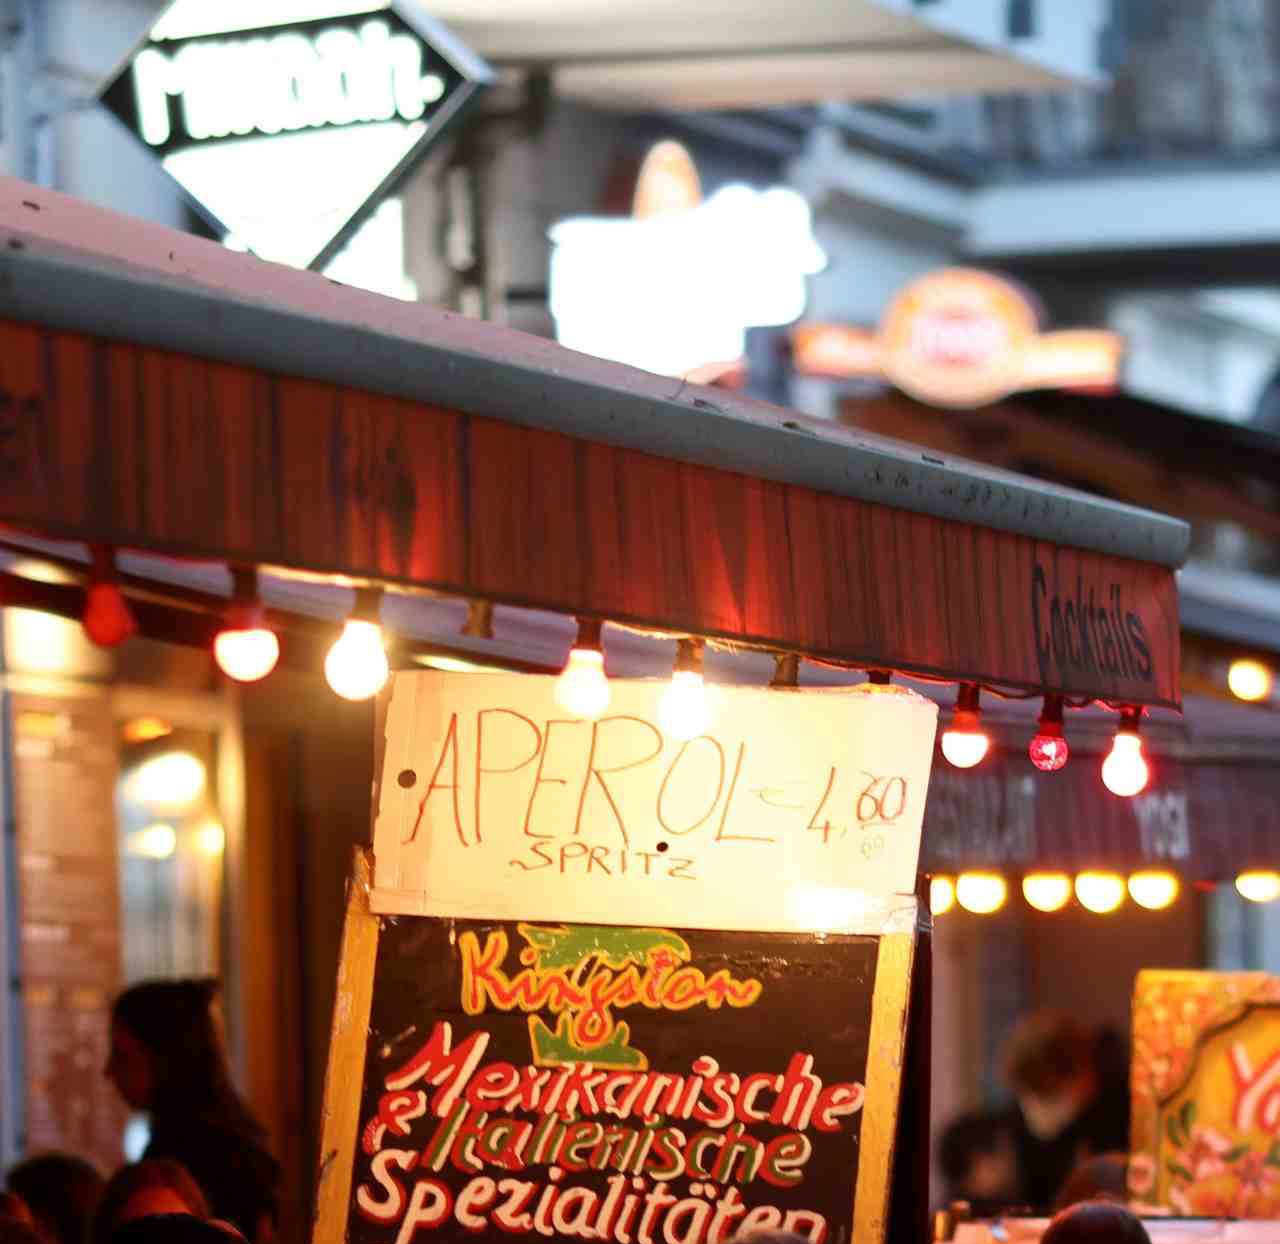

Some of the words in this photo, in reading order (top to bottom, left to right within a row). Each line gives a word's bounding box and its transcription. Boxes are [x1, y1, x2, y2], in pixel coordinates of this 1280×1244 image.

[1032, 564, 1152, 684] Cocktails
[401, 708, 774, 848] APEROL
[509, 841, 697, 881] SPRITZ
[386, 1021, 865, 1132] Mexikanische
[421, 1100, 811, 1188] Italienische
